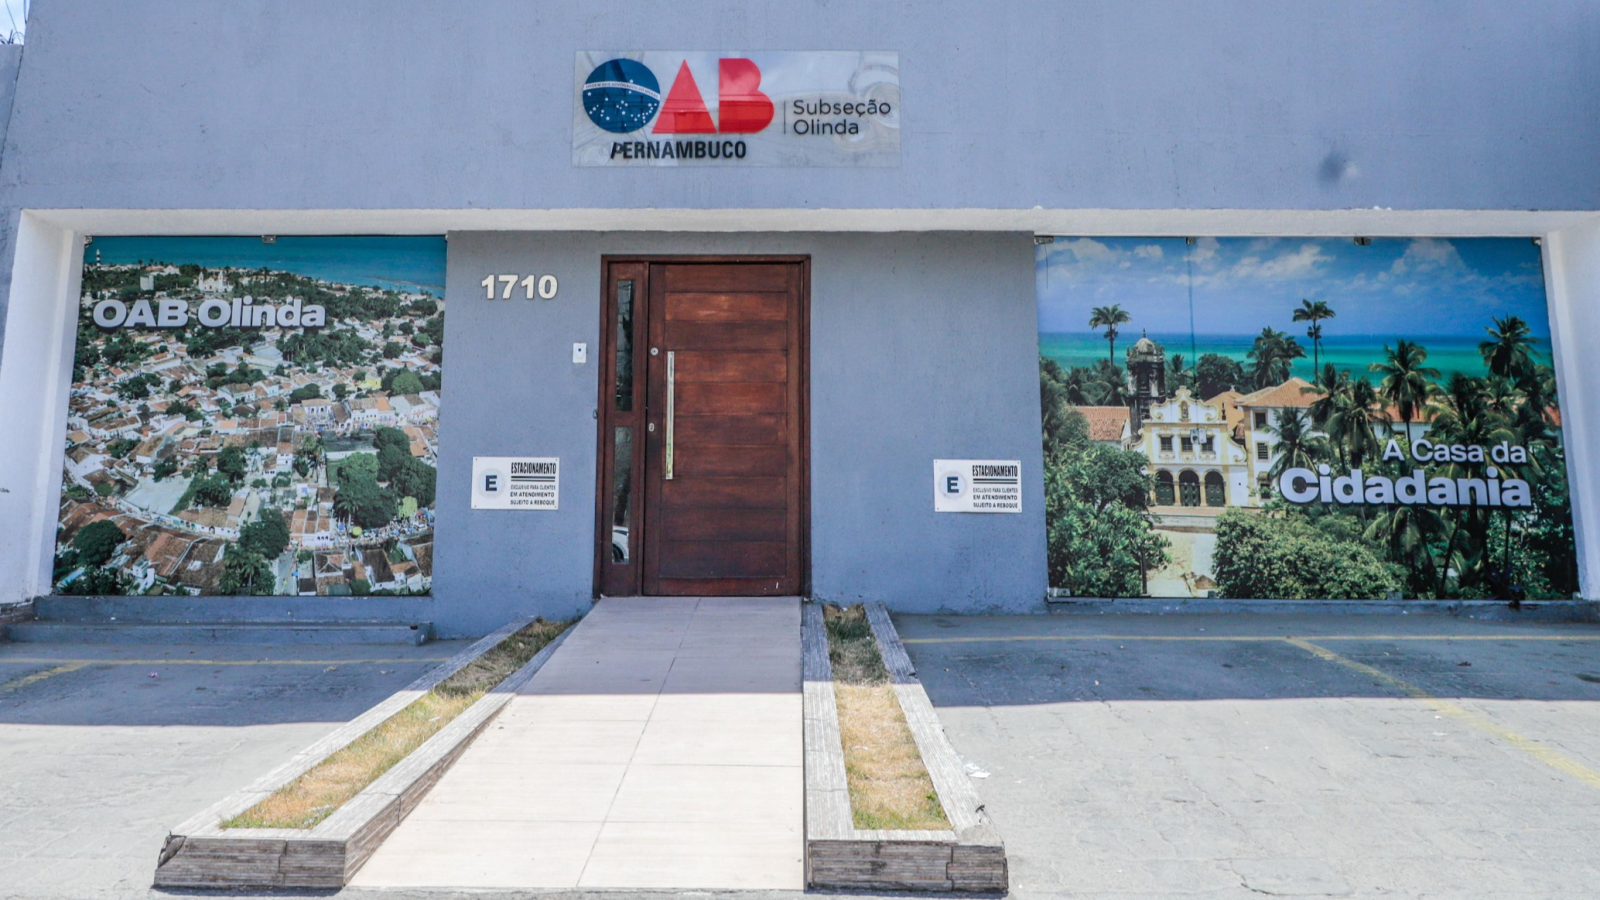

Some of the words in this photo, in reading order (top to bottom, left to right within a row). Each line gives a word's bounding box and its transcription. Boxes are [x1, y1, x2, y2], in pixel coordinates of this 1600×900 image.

[793, 100, 891, 117] Subseção
[793, 118, 859, 135] Olinda
[610, 141, 747, 160] PERNAMBUCO
[482, 274, 558, 298] 1710
[93, 300, 189, 328] OAB
[198, 296, 326, 328] Olinda
[1382, 439, 1404, 462] A
[1411, 439, 1484, 462] Casa
[1491, 440, 1527, 463] da
[510, 462, 556, 474] ESTACIONAMENTO
[972, 465, 1018, 477] ESTACIONAMENTO
[486, 475, 498, 492] E
[947, 476, 959, 493] E
[1280, 464, 1532, 507] Cidadania
